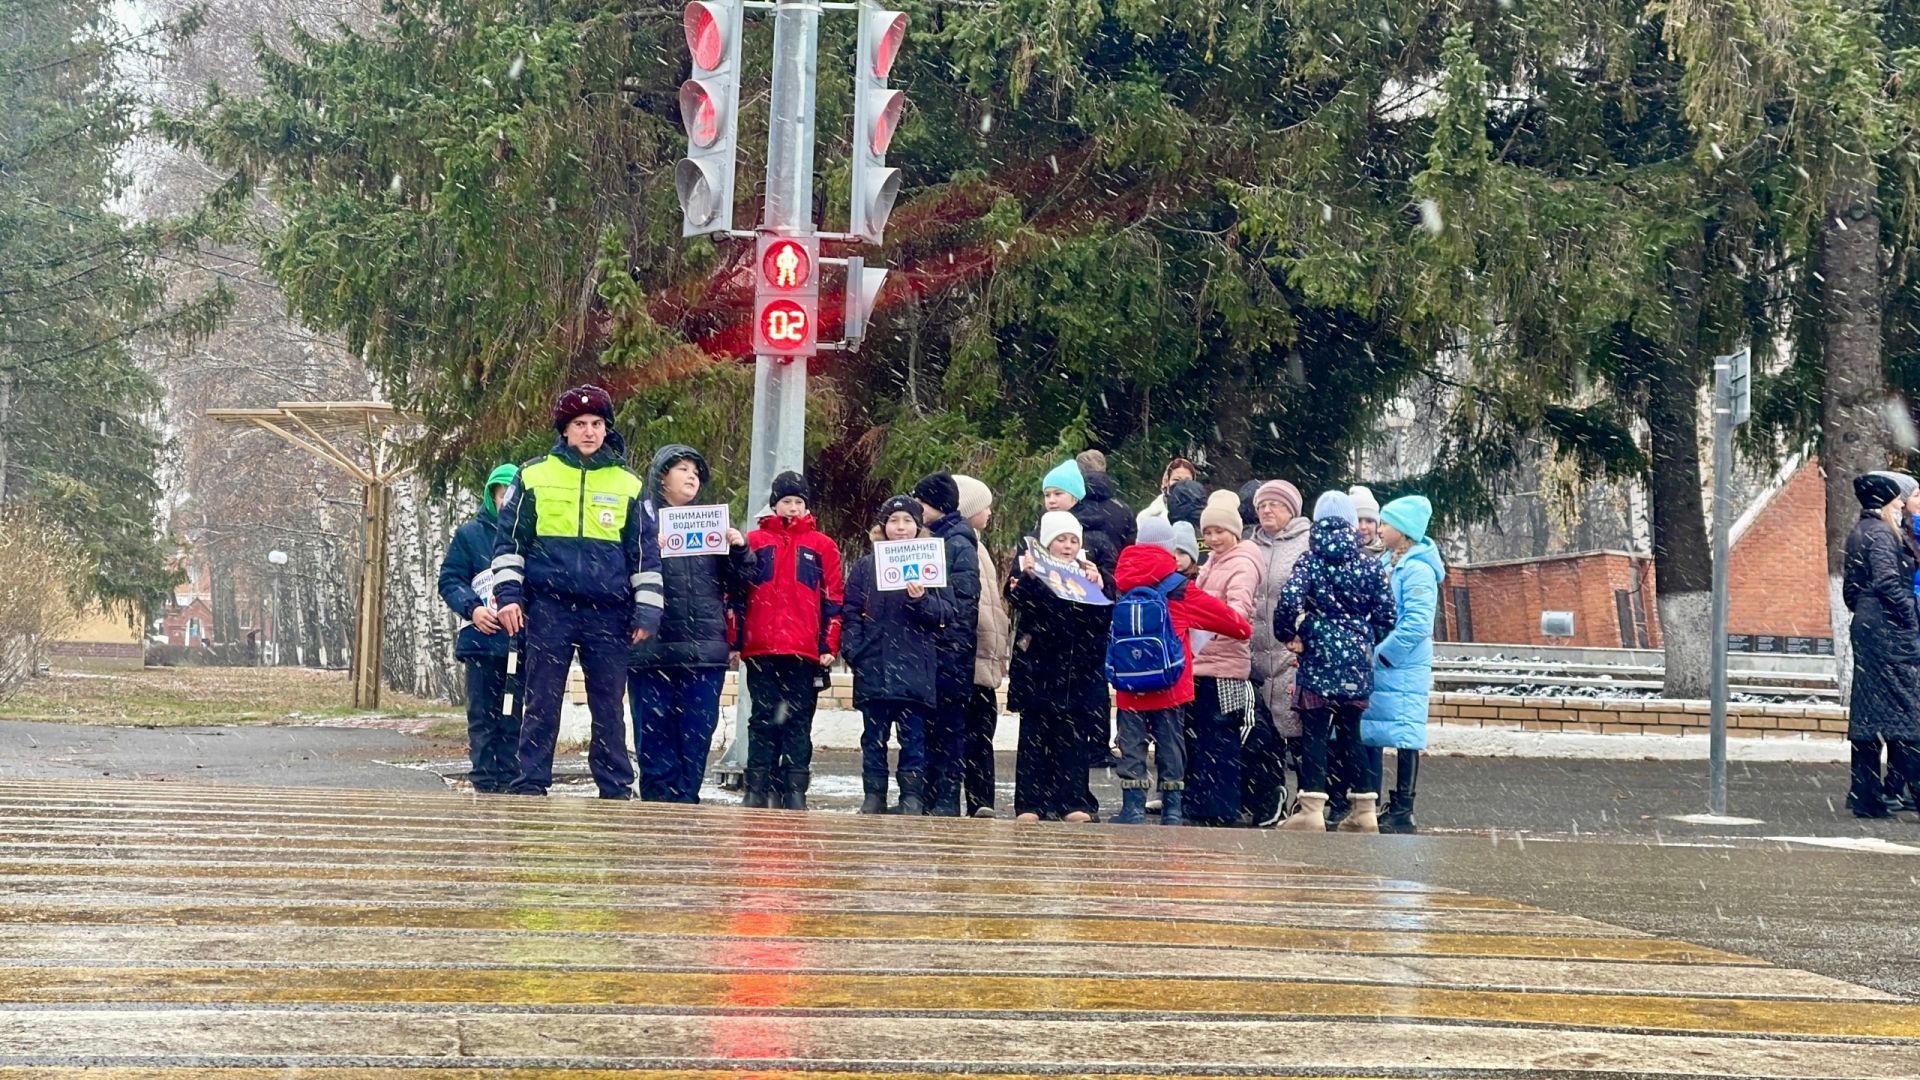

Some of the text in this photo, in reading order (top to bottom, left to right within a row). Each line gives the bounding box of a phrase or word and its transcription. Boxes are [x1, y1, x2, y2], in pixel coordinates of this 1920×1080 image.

[768, 311, 805, 340] 02
[668, 510, 722, 521] ВНИМАНИЕ!
[673, 520, 720, 530] ВОДИТЕЛЬ!
[671, 538, 680, 546] 10
[884, 543, 937, 555] ВНИМАНИЕ!
[889, 552, 935, 563] ВОДИТЕЛЬ!
[888, 571, 897, 580] 10
